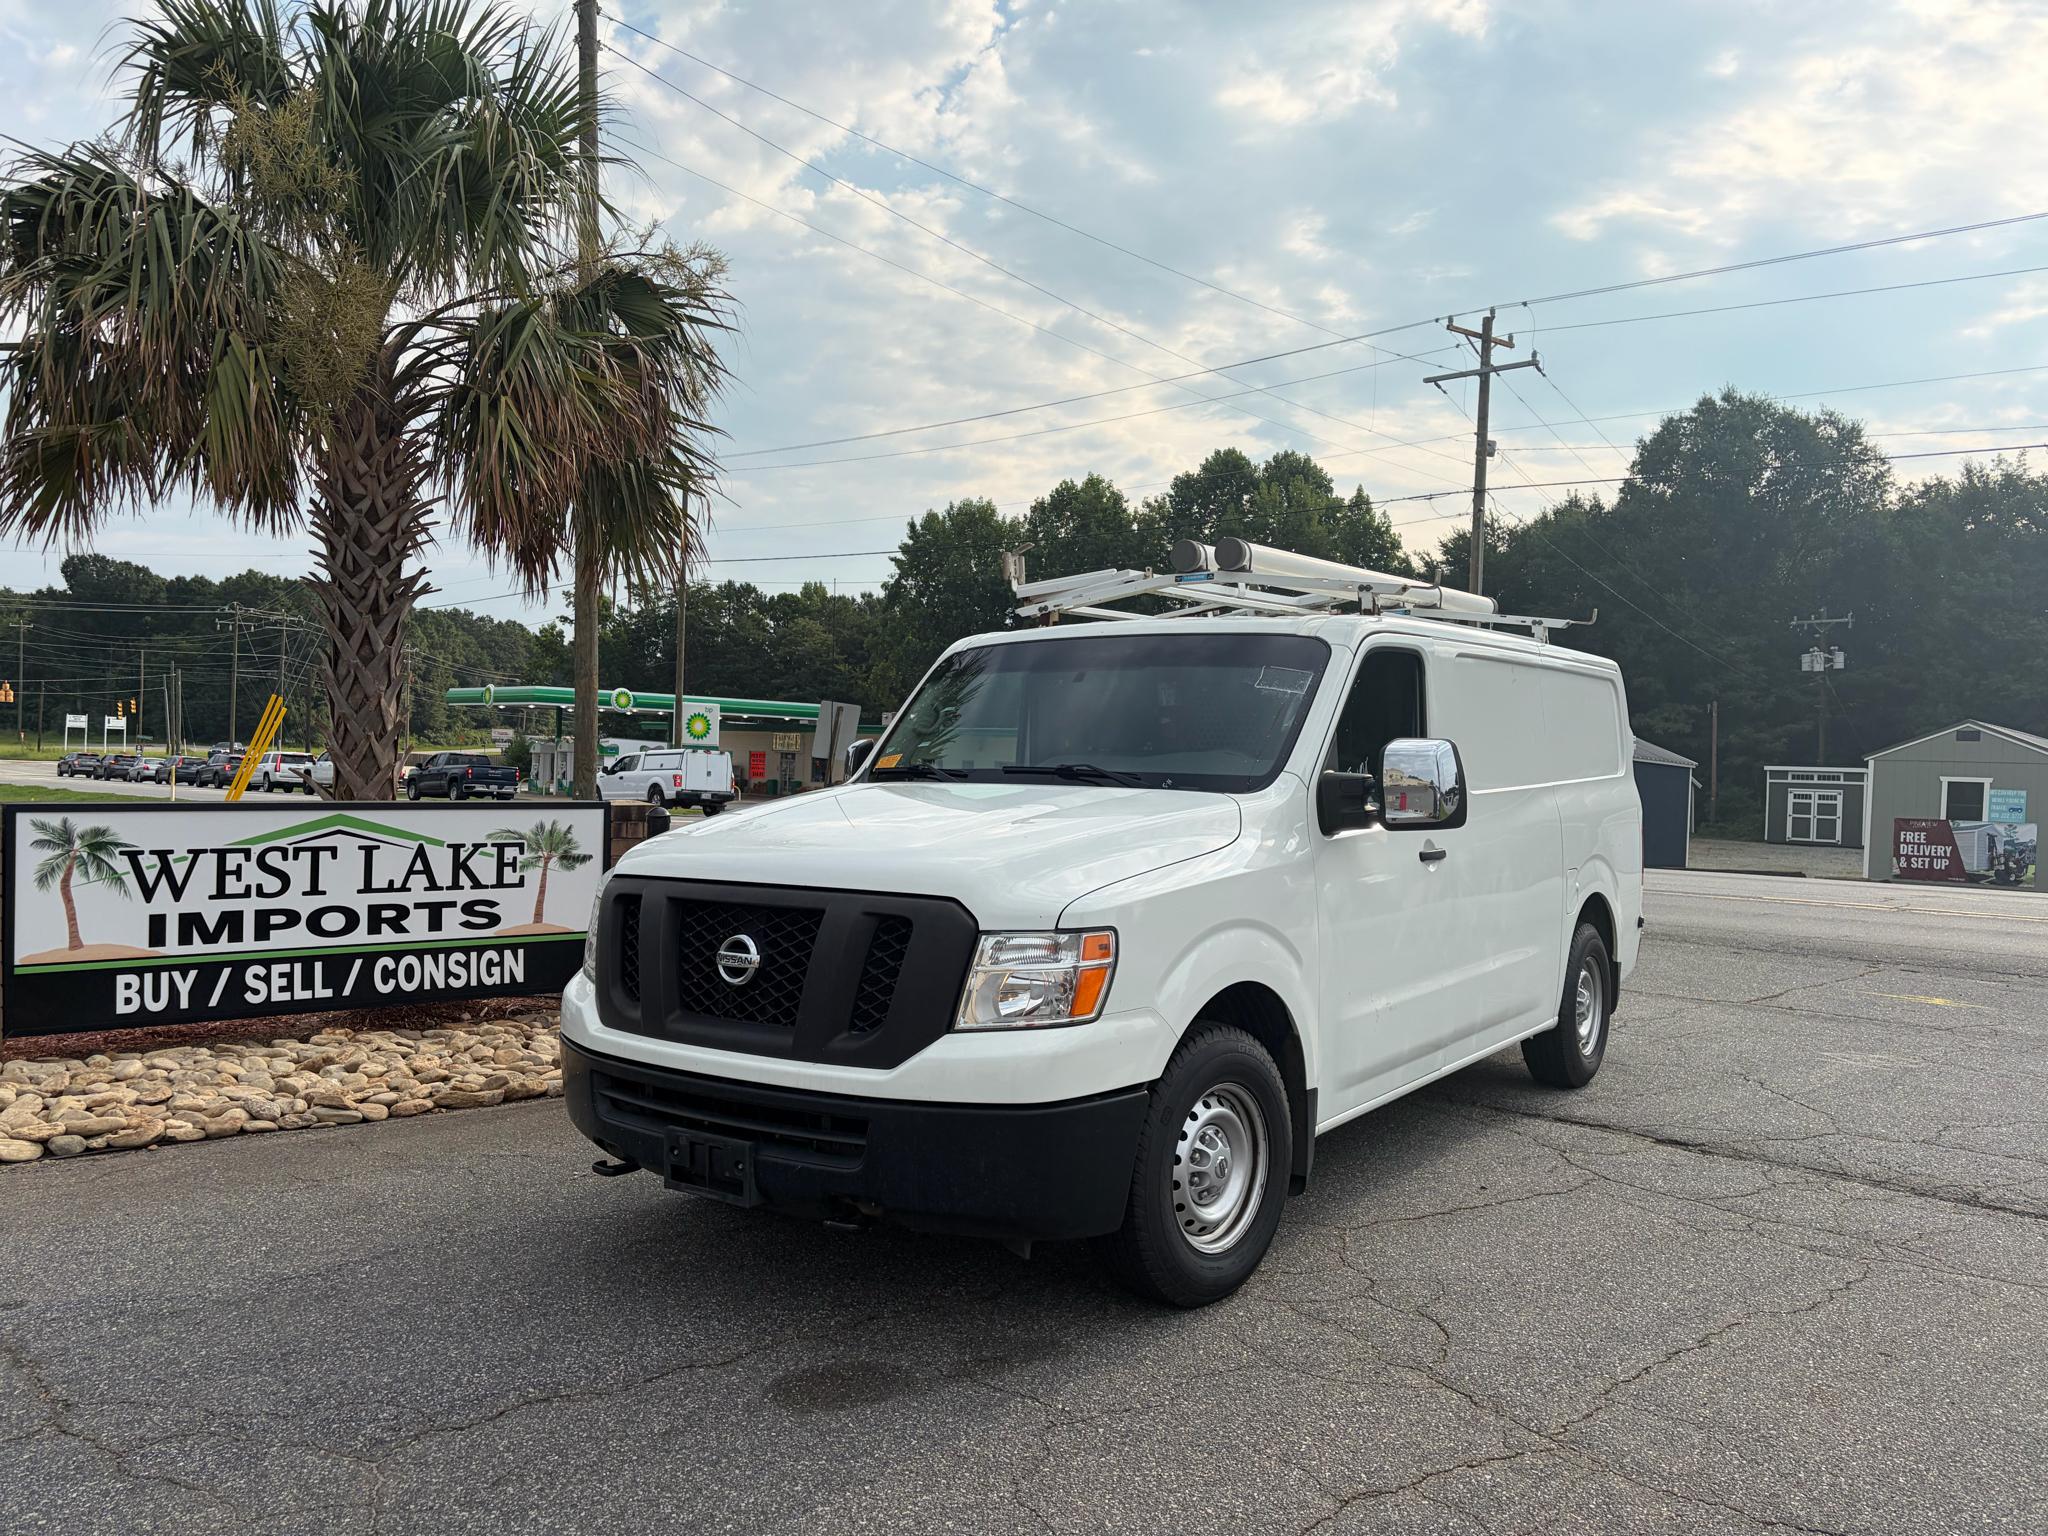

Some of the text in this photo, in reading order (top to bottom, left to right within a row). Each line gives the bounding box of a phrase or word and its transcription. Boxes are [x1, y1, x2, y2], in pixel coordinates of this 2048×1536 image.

[705, 706, 714, 714] bp
[1900, 831, 1927, 843] FREE
[1900, 844, 1952, 857] DELIVERY
[1900, 857, 1950, 870] & SET UP
[119, 842, 526, 904] WEST LAKE
[148, 899, 502, 948] IMPORTS
[717, 952, 753, 966] NISSAN
[115, 948, 525, 1015] BUY / SELL / CONSIGN
